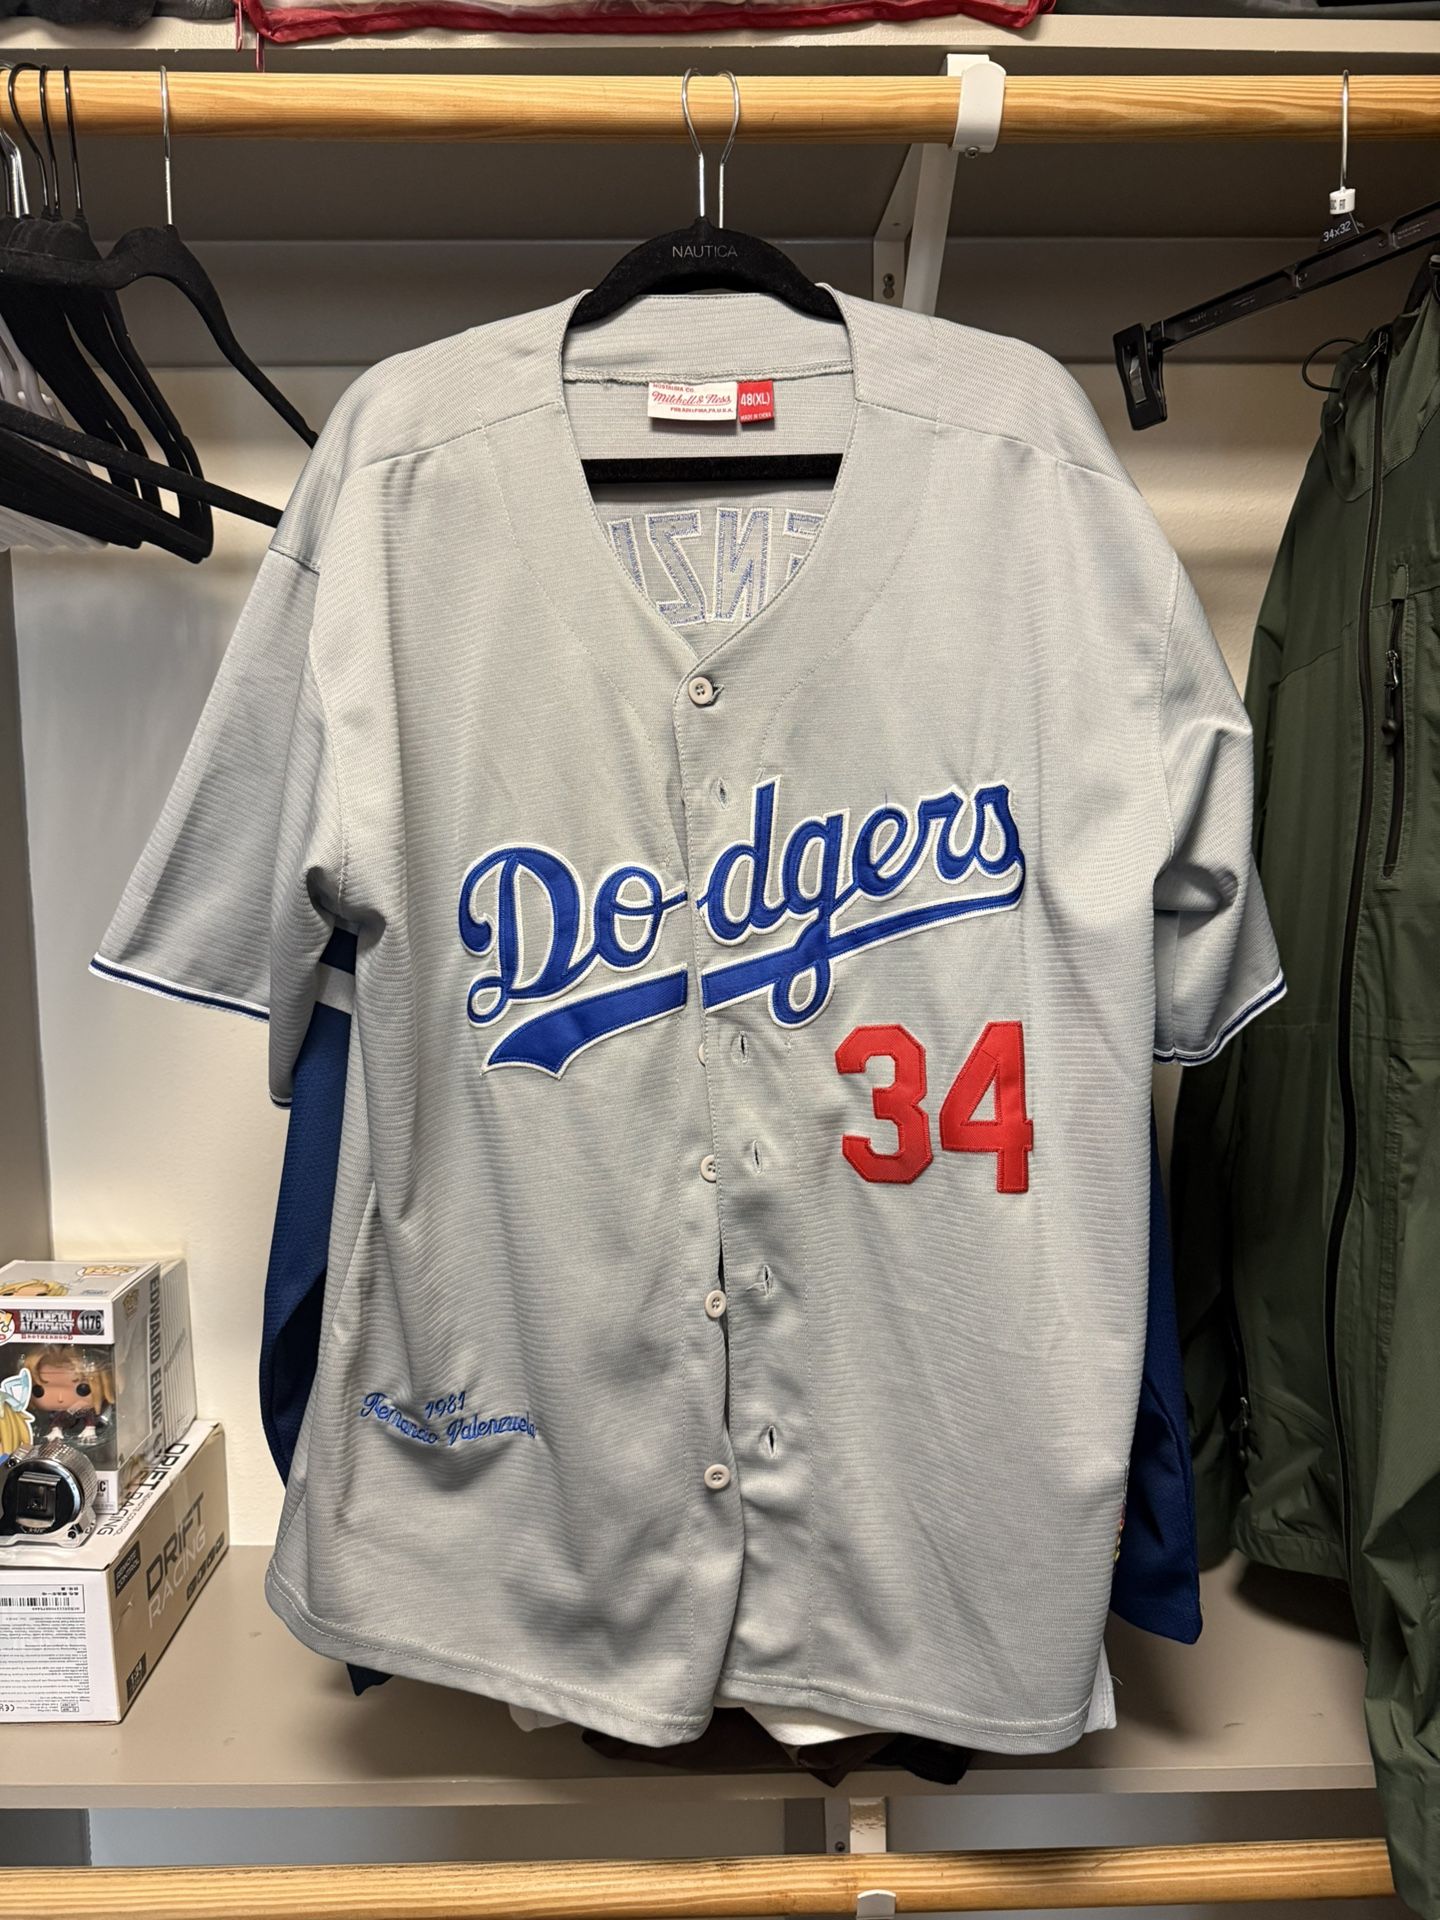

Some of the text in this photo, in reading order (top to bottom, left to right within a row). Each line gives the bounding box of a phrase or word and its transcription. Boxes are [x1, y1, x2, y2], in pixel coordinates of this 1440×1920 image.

[1323, 221, 1352, 242] 34x32
[672, 245, 738, 258] NAUTICA
[652, 390, 697, 405] Mitchell
[705, 394, 732, 405] Ness
[741, 393, 771, 407] 48(XL)
[458, 776, 1027, 1079] Dodgers
[834, 1021, 1034, 1194] 34
[20, 1310, 74, 1323] FULLMETAL
[20, 1321, 74, 1333] ALCHEMIST
[80, 1315, 102, 1330] 1176
[148, 1275, 163, 1430] EDWARD ELRIC
[425, 1391, 466, 1420] 1981
[445, 1411, 537, 1446] Valenzuela
[146, 1492, 205, 1601] DRIFT
[148, 1527, 207, 1629] RACING
